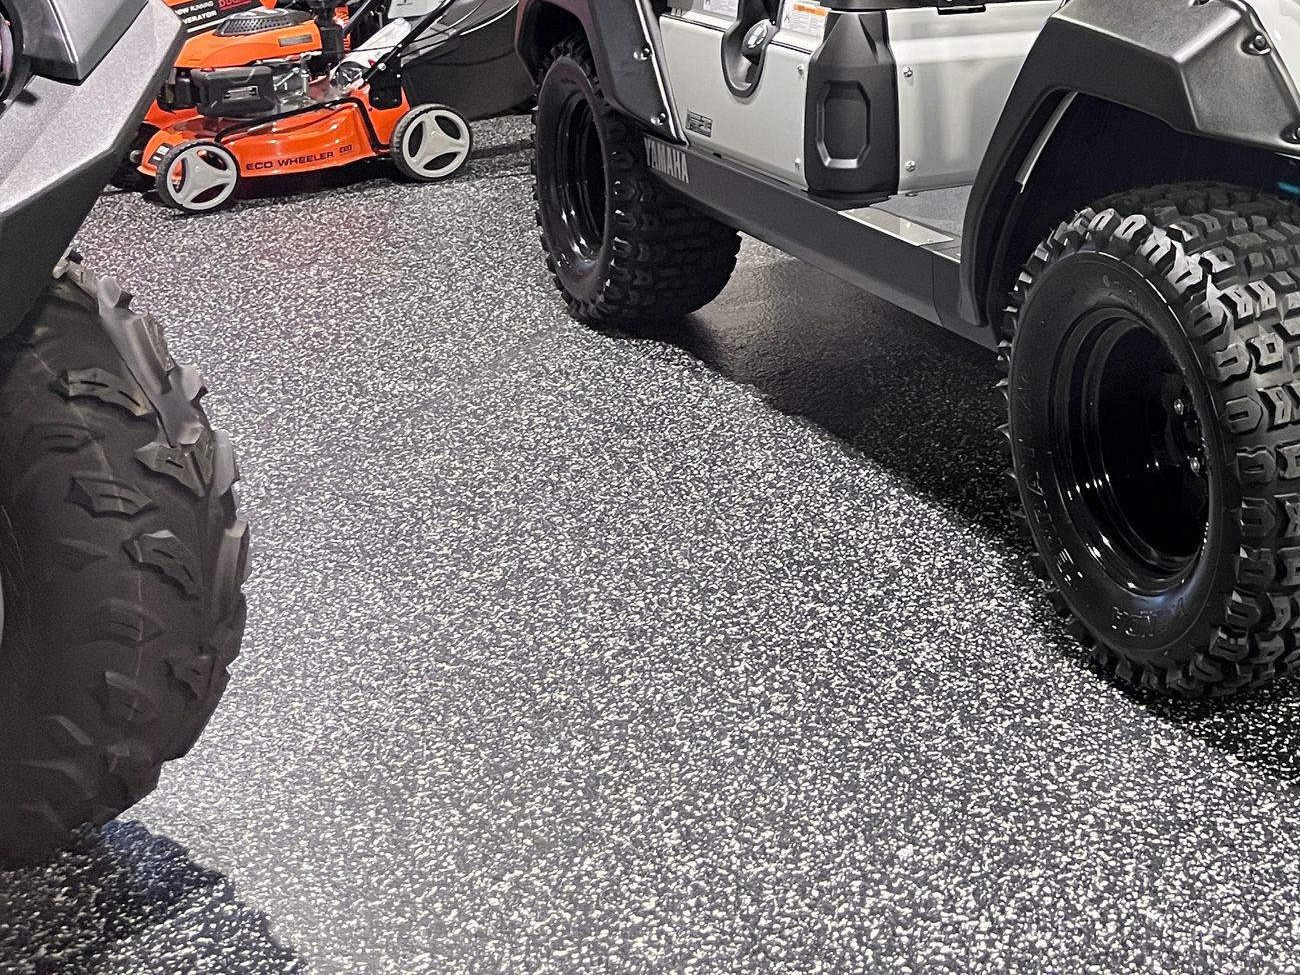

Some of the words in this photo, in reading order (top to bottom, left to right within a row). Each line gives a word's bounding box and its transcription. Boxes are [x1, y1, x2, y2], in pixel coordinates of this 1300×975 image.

[246, 161, 273, 170] ECO
[277, 151, 334, 167] WHEELER
[643, 136, 690, 184] YAMAHA
